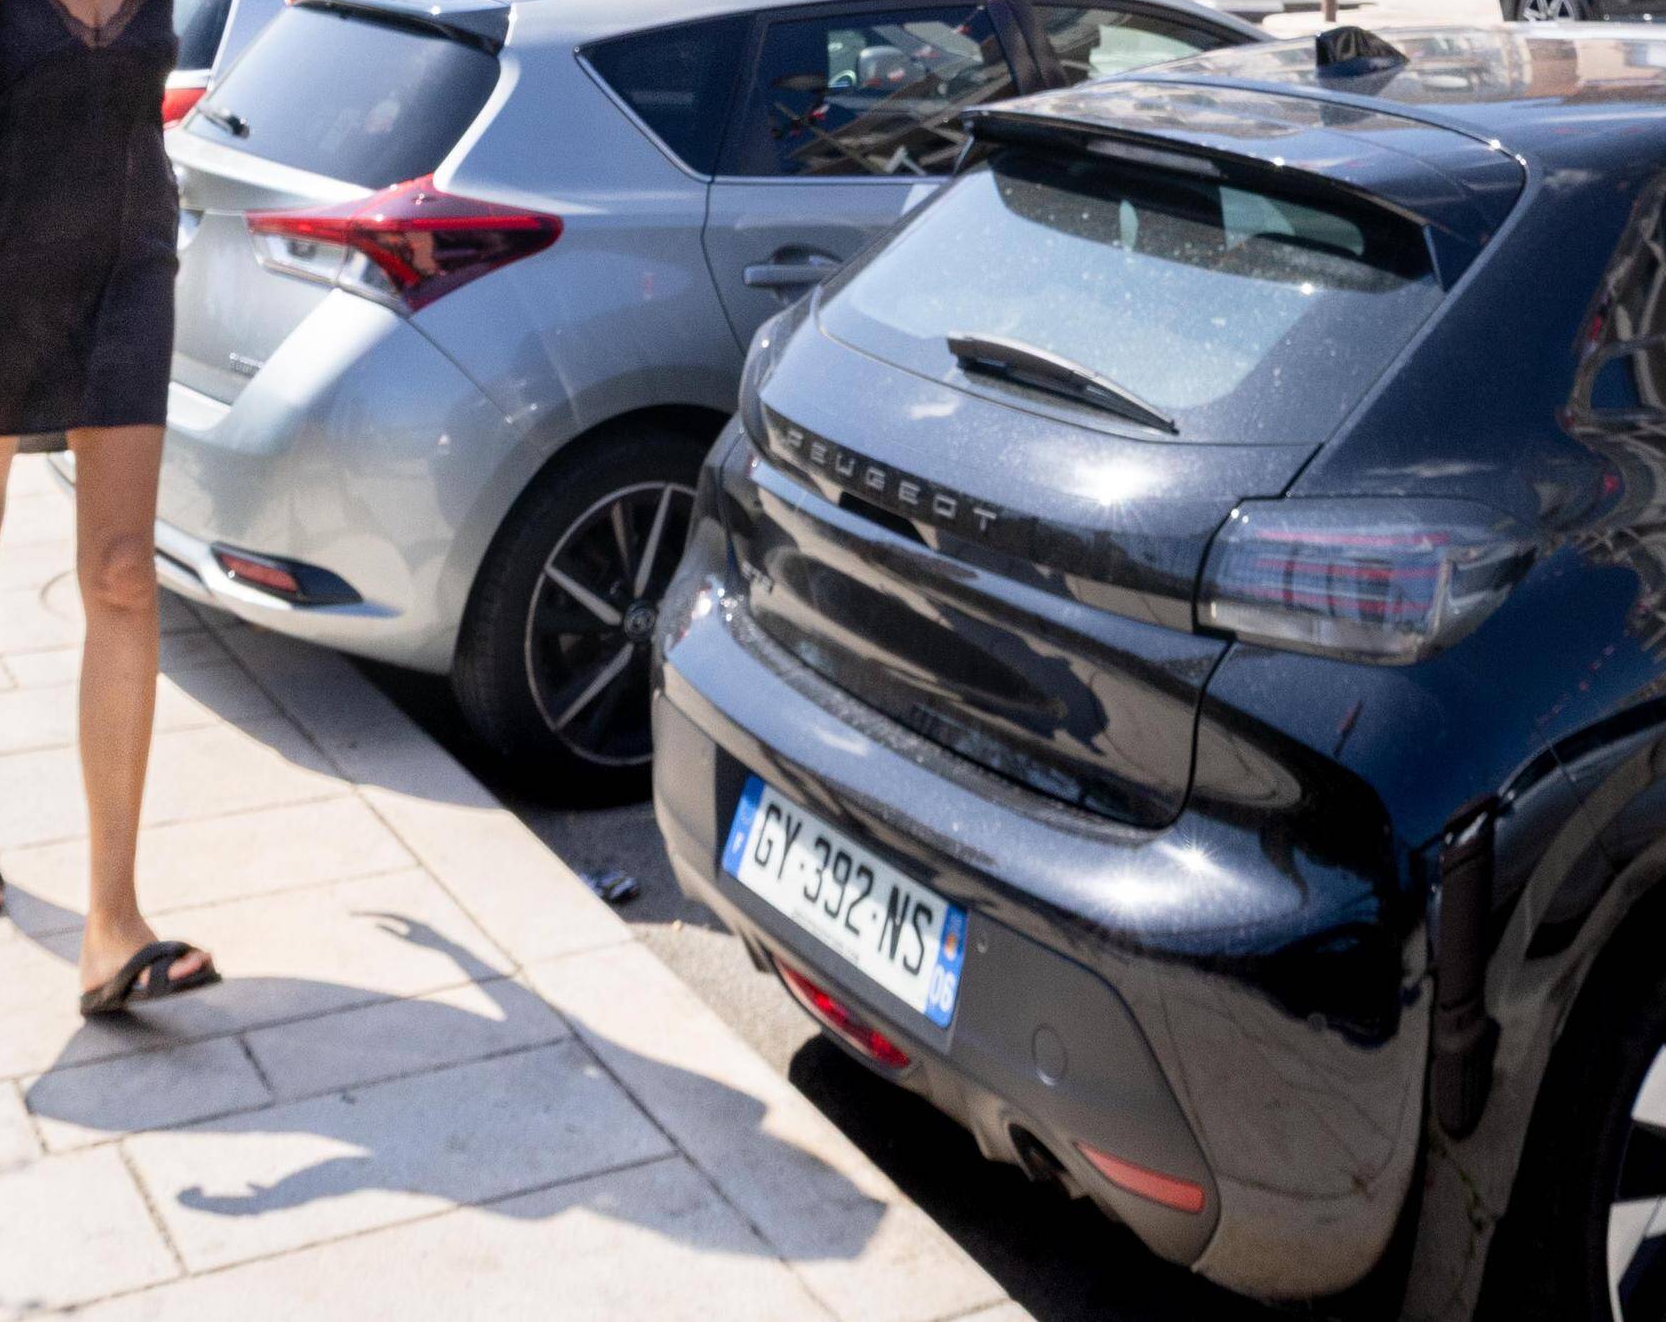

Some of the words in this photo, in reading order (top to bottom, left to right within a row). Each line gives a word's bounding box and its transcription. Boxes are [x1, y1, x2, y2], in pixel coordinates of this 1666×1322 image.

[784, 428, 998, 533] PEUGEOT
[754, 802, 933, 977] GY-392-NS
[929, 964, 957, 1013] 06
